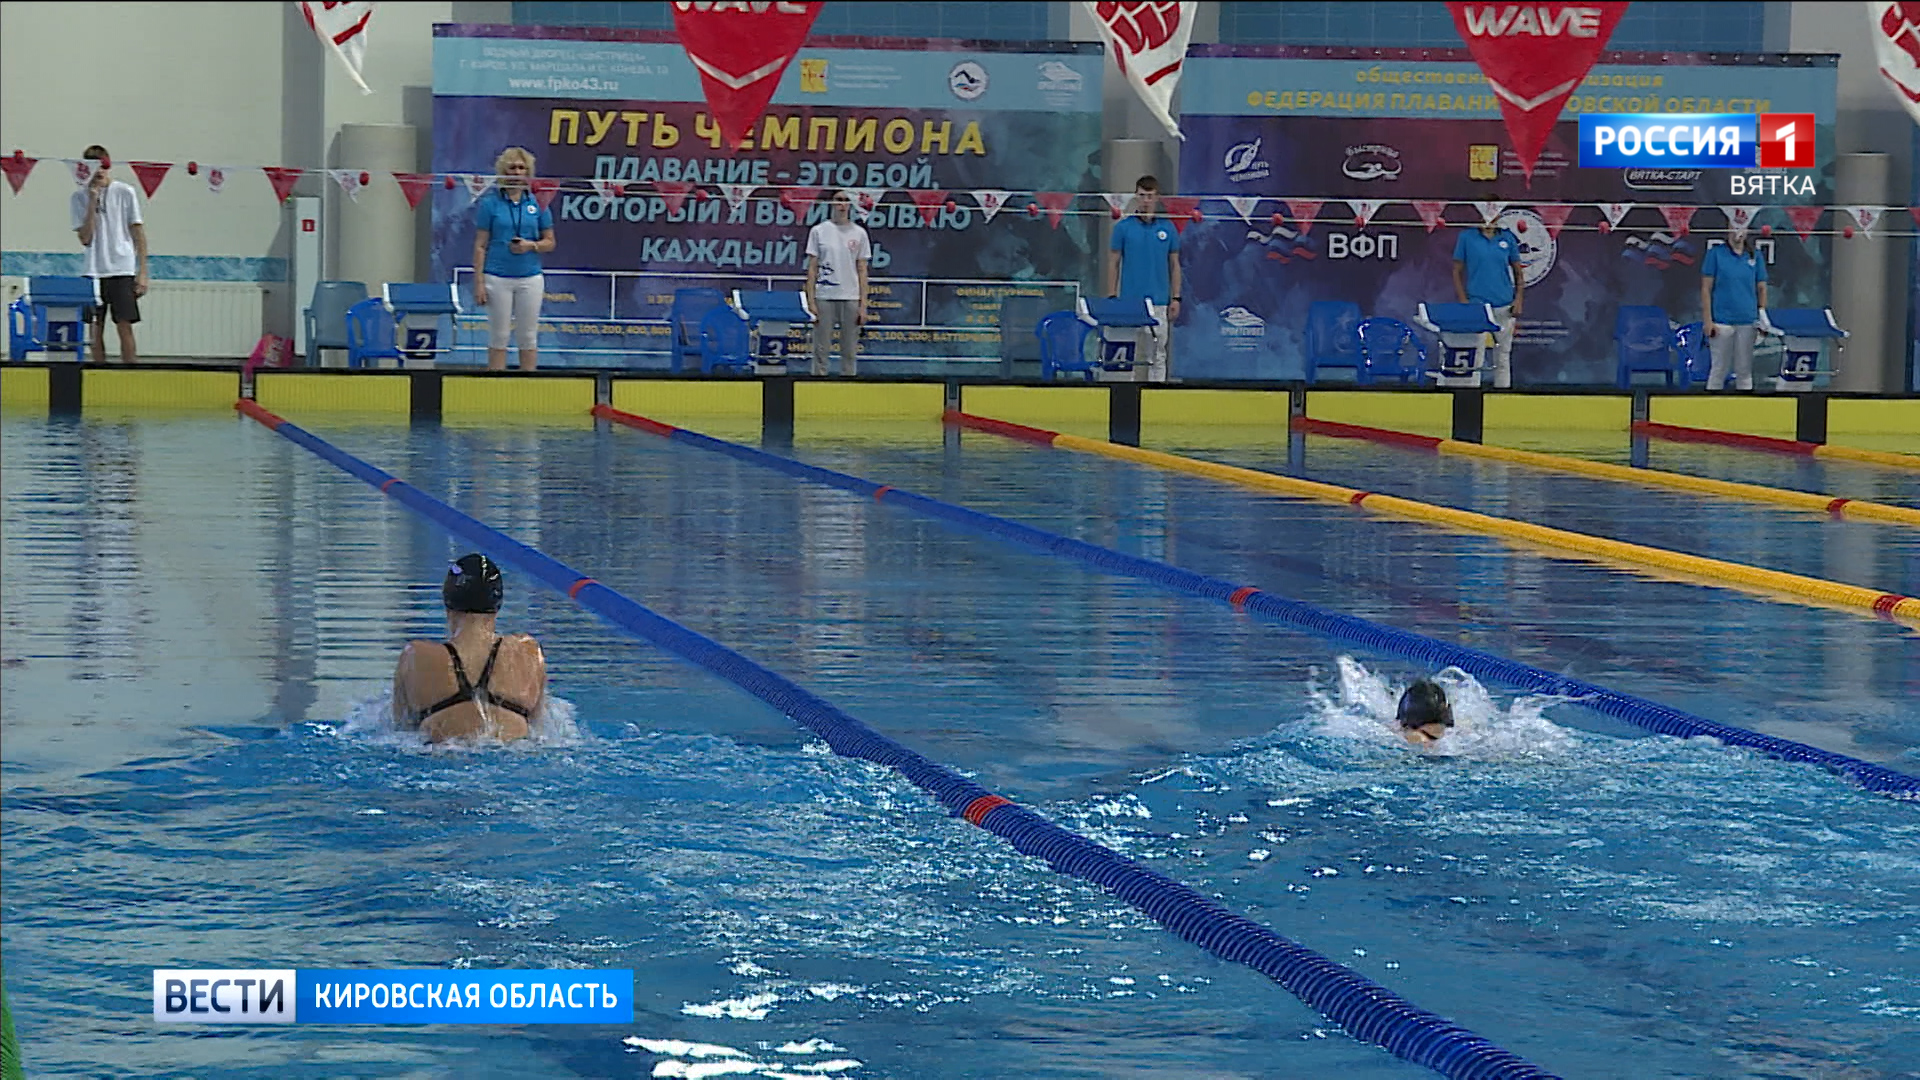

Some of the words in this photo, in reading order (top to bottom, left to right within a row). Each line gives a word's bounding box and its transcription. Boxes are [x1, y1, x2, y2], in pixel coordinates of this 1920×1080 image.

[1464, 6, 1602, 38] WAVE
[509, 77, 619, 91] www.fpko43.ru
[1356, 66, 1488, 86] обществен
[1247, 90, 1385, 112] ФЕДЕРАЦИЯ
[1390, 92, 1498, 112] ПЛАВАНИ
[1664, 97, 1772, 114] ОБЛАСТИ
[548, 109, 680, 148] ПУТЬ
[594, 155, 770, 185] ПЛАВАНИЕ
[797, 161, 859, 187] ЭТО
[866, 158, 940, 189] БОЙ,
[1629, 170, 1703, 181] ВЯТКА-СТАРТ
[561, 194, 721, 224] КОТОРЫЙ
[640, 235, 797, 268] КАЖДЫЙ
[1327, 232, 1399, 260] ВФП
[56, 325, 69, 349] 1
[415, 333, 432, 357] 2
[767, 340, 784, 364] 3
[1111, 346, 1128, 367] 4
[1453, 351, 1470, 374] 5
[1795, 355, 1812, 378] 6
